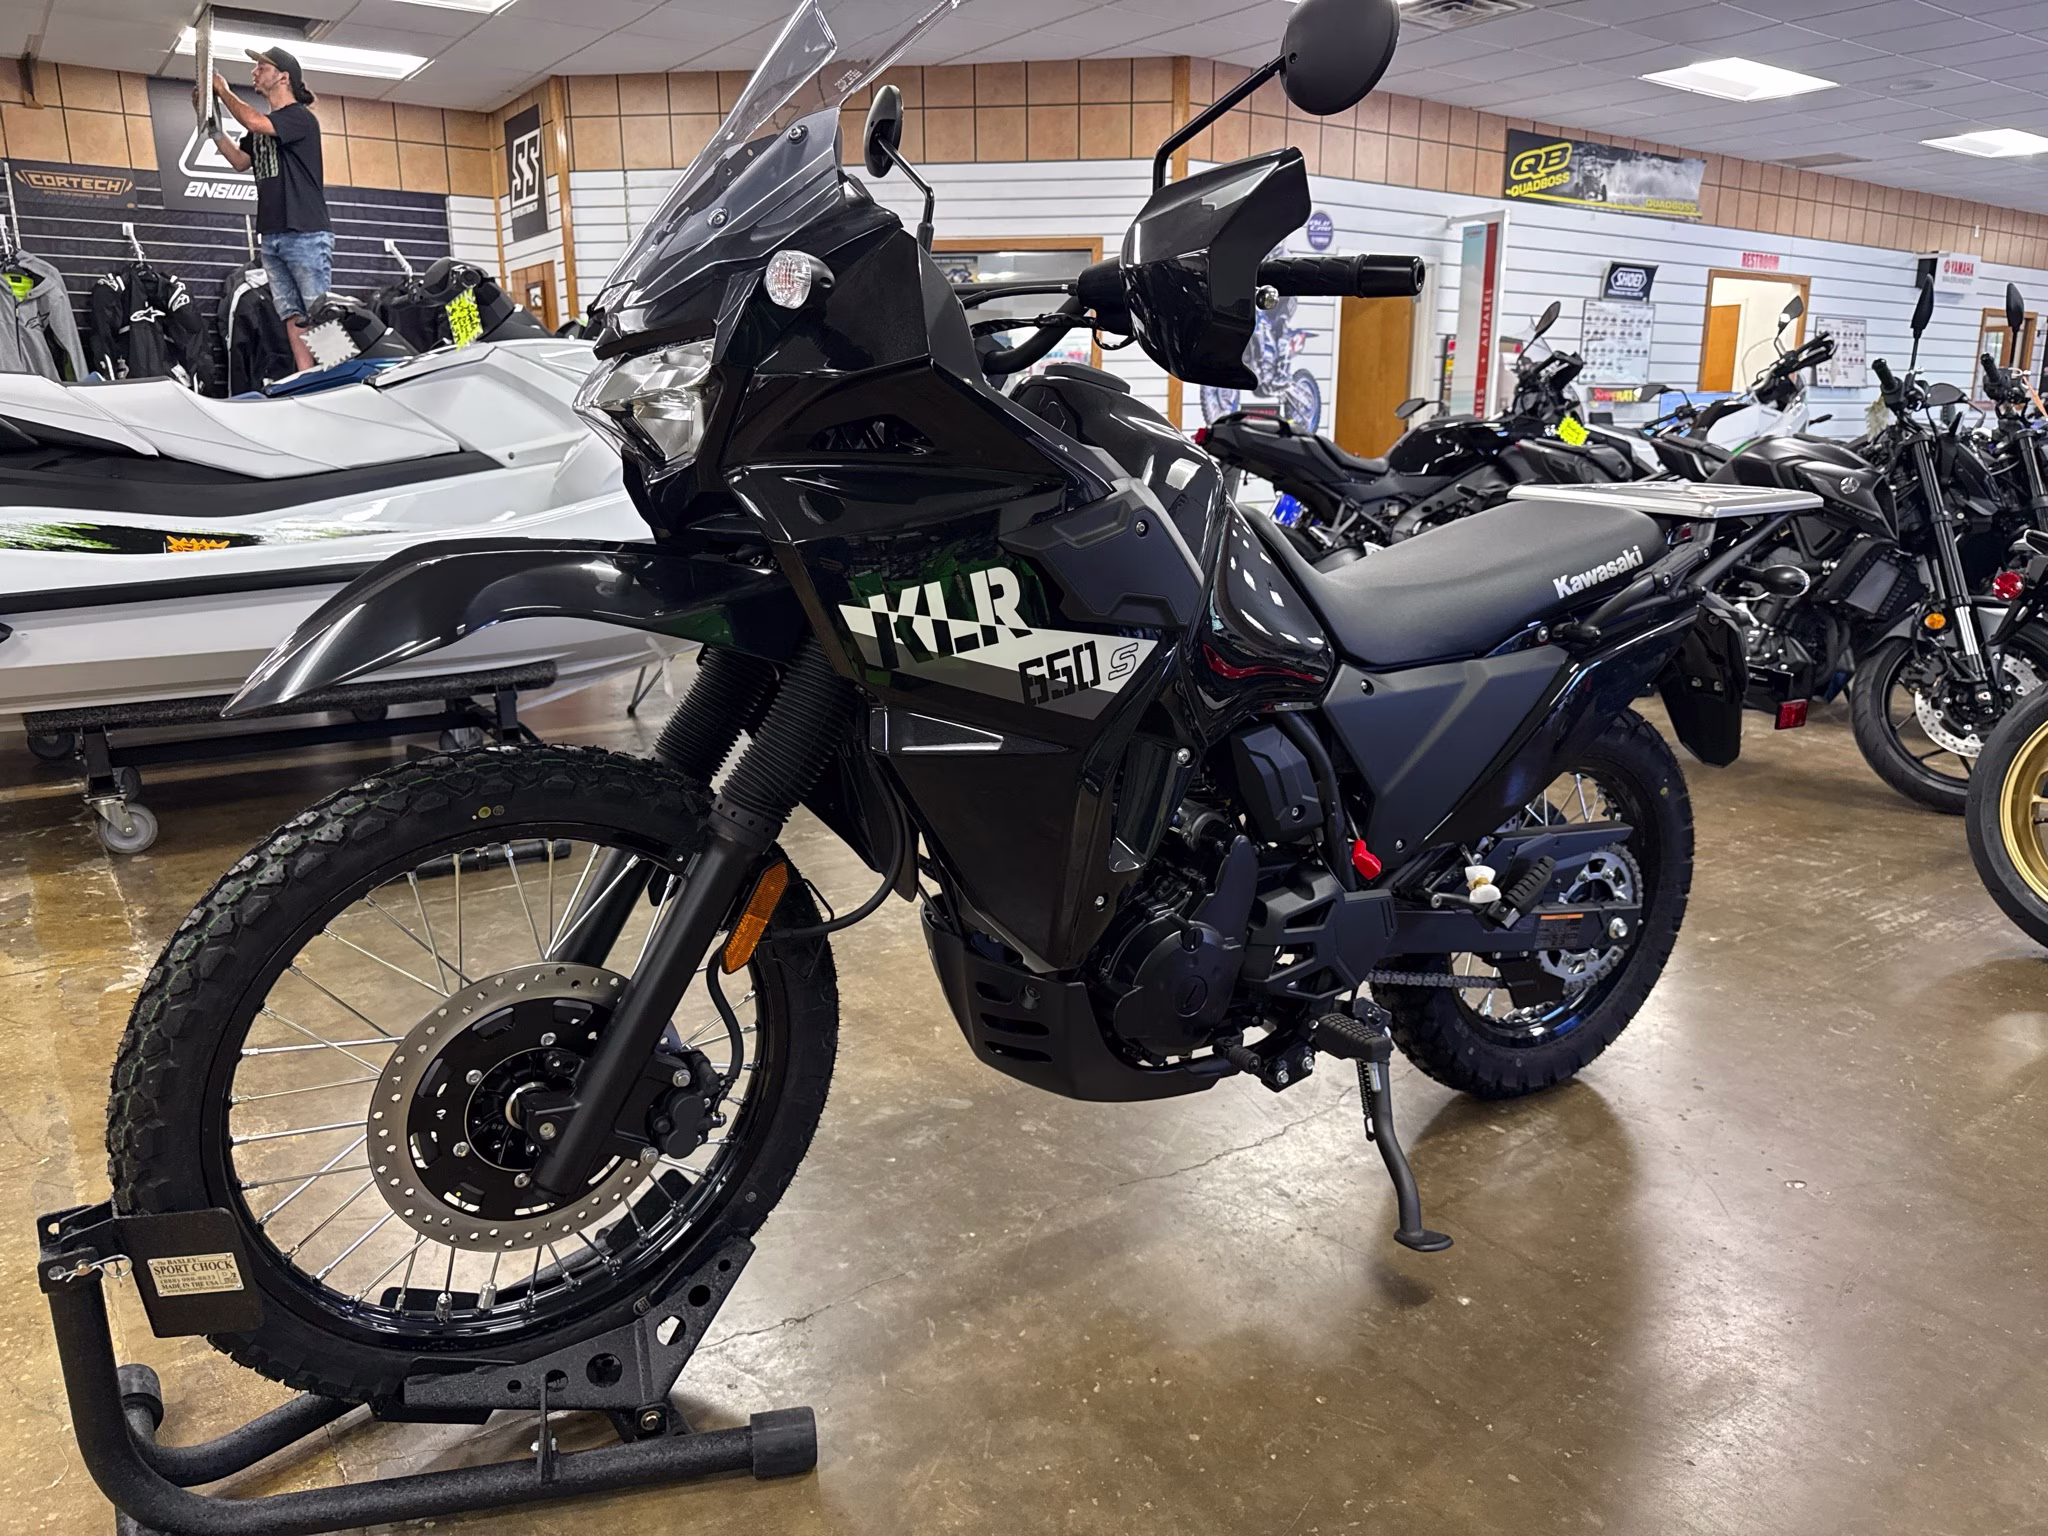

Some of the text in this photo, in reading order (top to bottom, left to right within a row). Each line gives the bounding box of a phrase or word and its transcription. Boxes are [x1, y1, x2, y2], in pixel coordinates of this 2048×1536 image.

[1510, 142, 1572, 180] QB
[27, 173, 122, 192] CORTECH
[1510, 171, 1571, 198] QUADBOSS
[1645, 199, 1697, 213] QUADBOSS
[1742, 252, 1779, 270] RESTROOM
[1616, 272, 1643, 287] SHOEI
[1481, 288, 1493, 347] APPAREL
[1552, 545, 1644, 599] Kawasaki
[868, 566, 1033, 669] KLR
[1018, 640, 1139, 707] 650 S
[153, 1260, 234, 1275] SPORT CHOCK
[167, 1257, 197, 1266] BAXLEY
